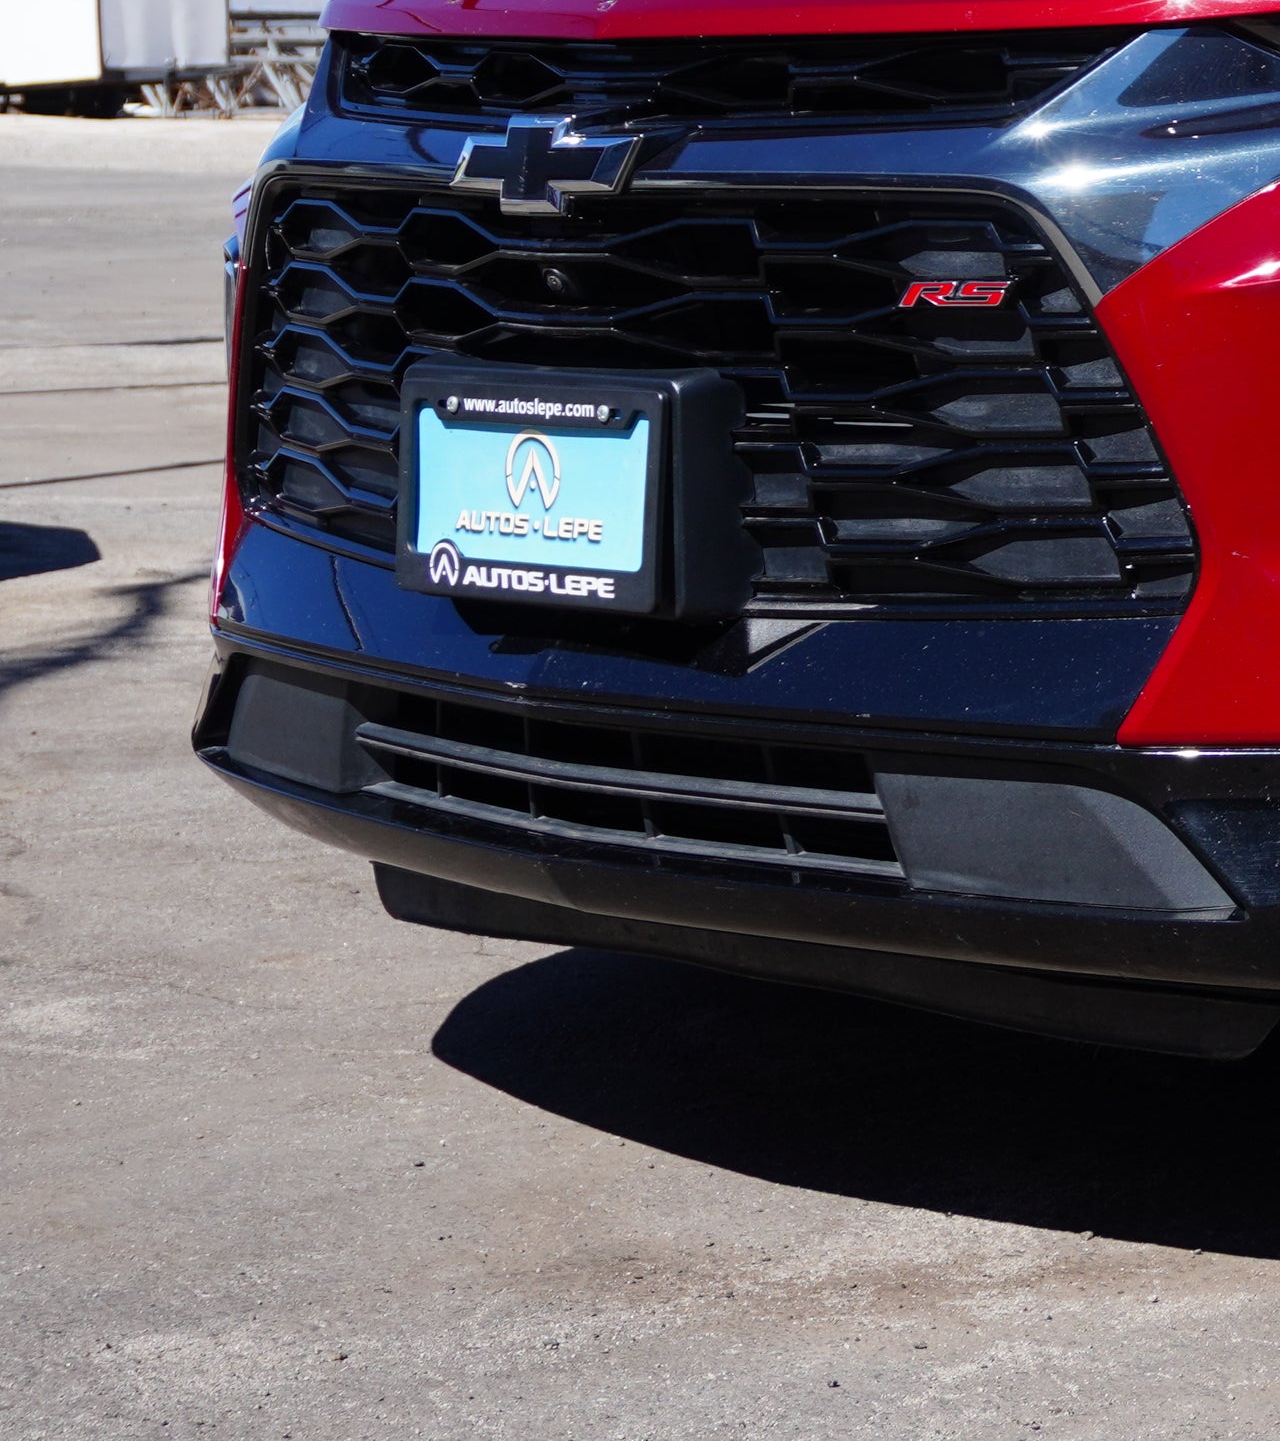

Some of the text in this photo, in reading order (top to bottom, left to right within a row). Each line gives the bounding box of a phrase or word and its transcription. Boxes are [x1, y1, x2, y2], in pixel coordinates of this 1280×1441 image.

[898, 281, 1011, 307] RS
[463, 397, 595, 419] www.autoslepe.com
[456, 509, 603, 541] AUTOS LEPE
